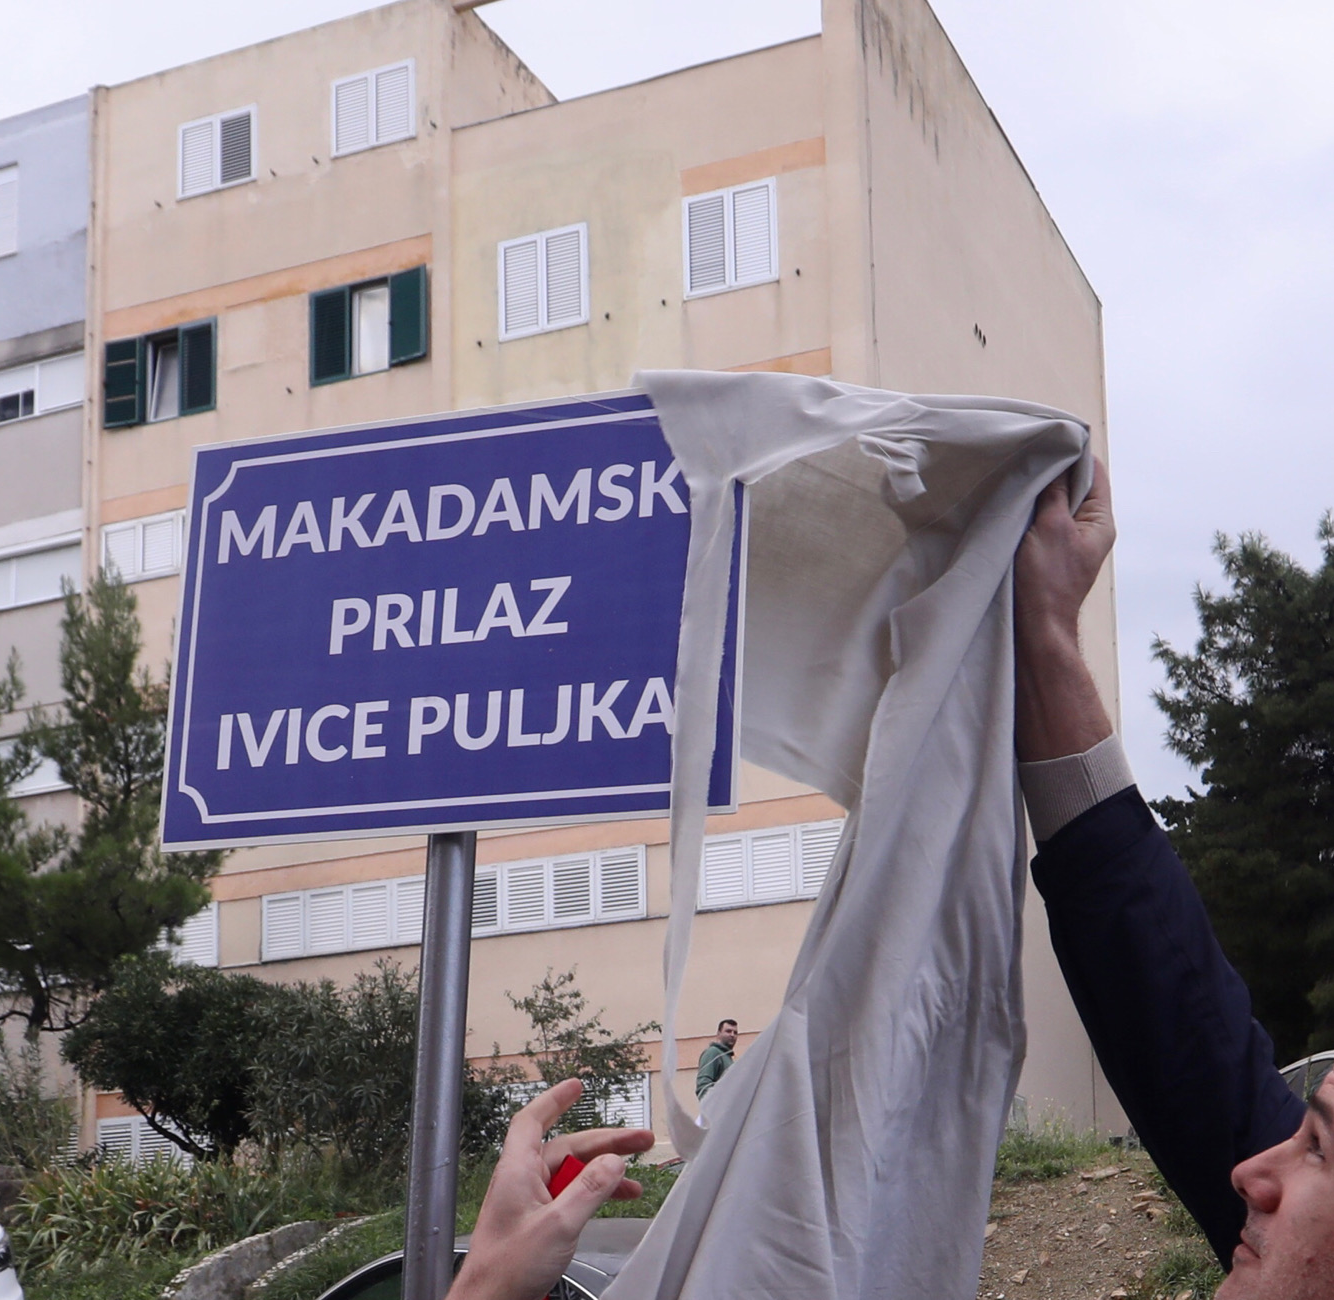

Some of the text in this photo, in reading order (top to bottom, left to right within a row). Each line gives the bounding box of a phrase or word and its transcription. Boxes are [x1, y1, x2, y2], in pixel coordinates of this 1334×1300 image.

[328, 575, 572, 656] PRILAZ
[216, 676, 676, 771] IVICE PULJKA
